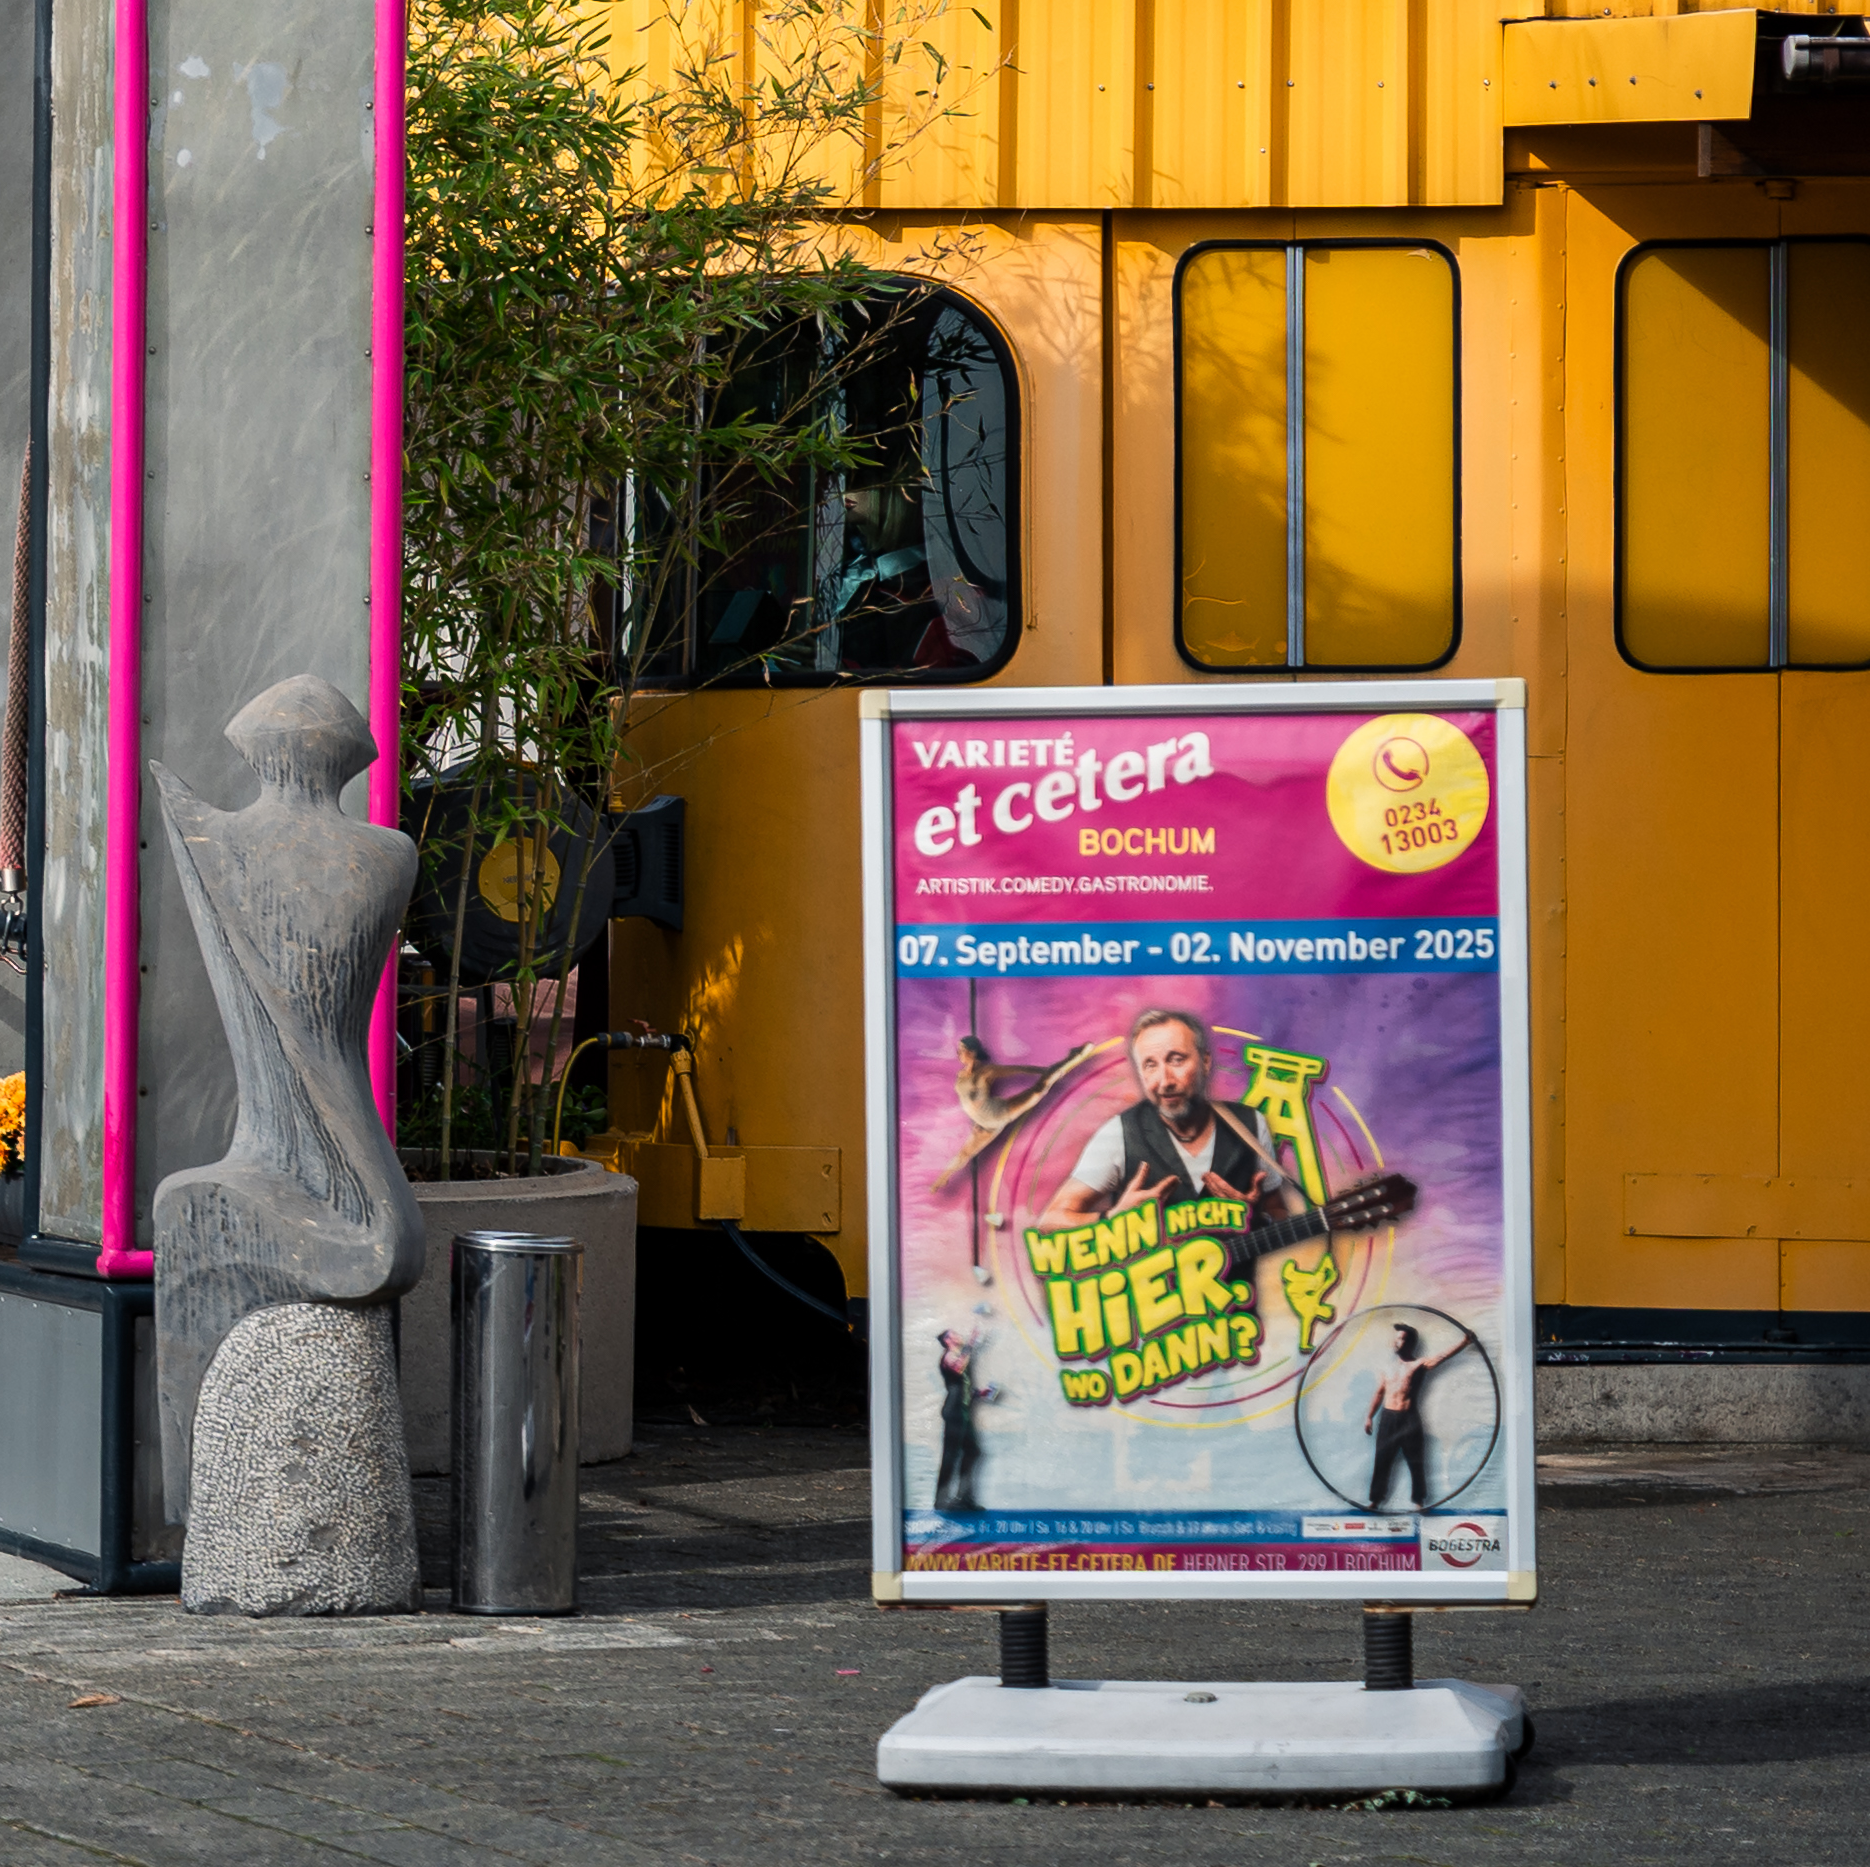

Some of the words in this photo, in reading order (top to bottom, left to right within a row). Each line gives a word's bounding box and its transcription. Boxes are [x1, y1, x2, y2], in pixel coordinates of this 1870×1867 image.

[912, 731, 1075, 769] VARIETÉ
[914, 783, 983, 856] et
[992, 731, 1215, 833] cetera
[1384, 798, 1441, 827] 0234
[1079, 827, 1216, 856] BOCHUM
[1381, 819, 1458, 854] 13003
[915, 875, 1214, 895] ARTISTIK.COMEDY.GASTRONOMIE.
[898, 936, 949, 966] 07.
[956, 934, 1140, 972] September
[1170, 933, 1222, 964] 02.
[1230, 931, 1406, 963] November
[1414, 929, 1495, 960] 2025
[1025, 1201, 1159, 1274] WENN
[1062, 1372, 1108, 1399] WO
[1111, 1315, 1259, 1397] DANN?
[1184, 1553, 1249, 1571] HERNER
[1297, 1553, 1328, 1571] 299
[1345, 1553, 1416, 1571] BOCHUM
[1428, 1538, 1501, 1552] BOGESTRA
